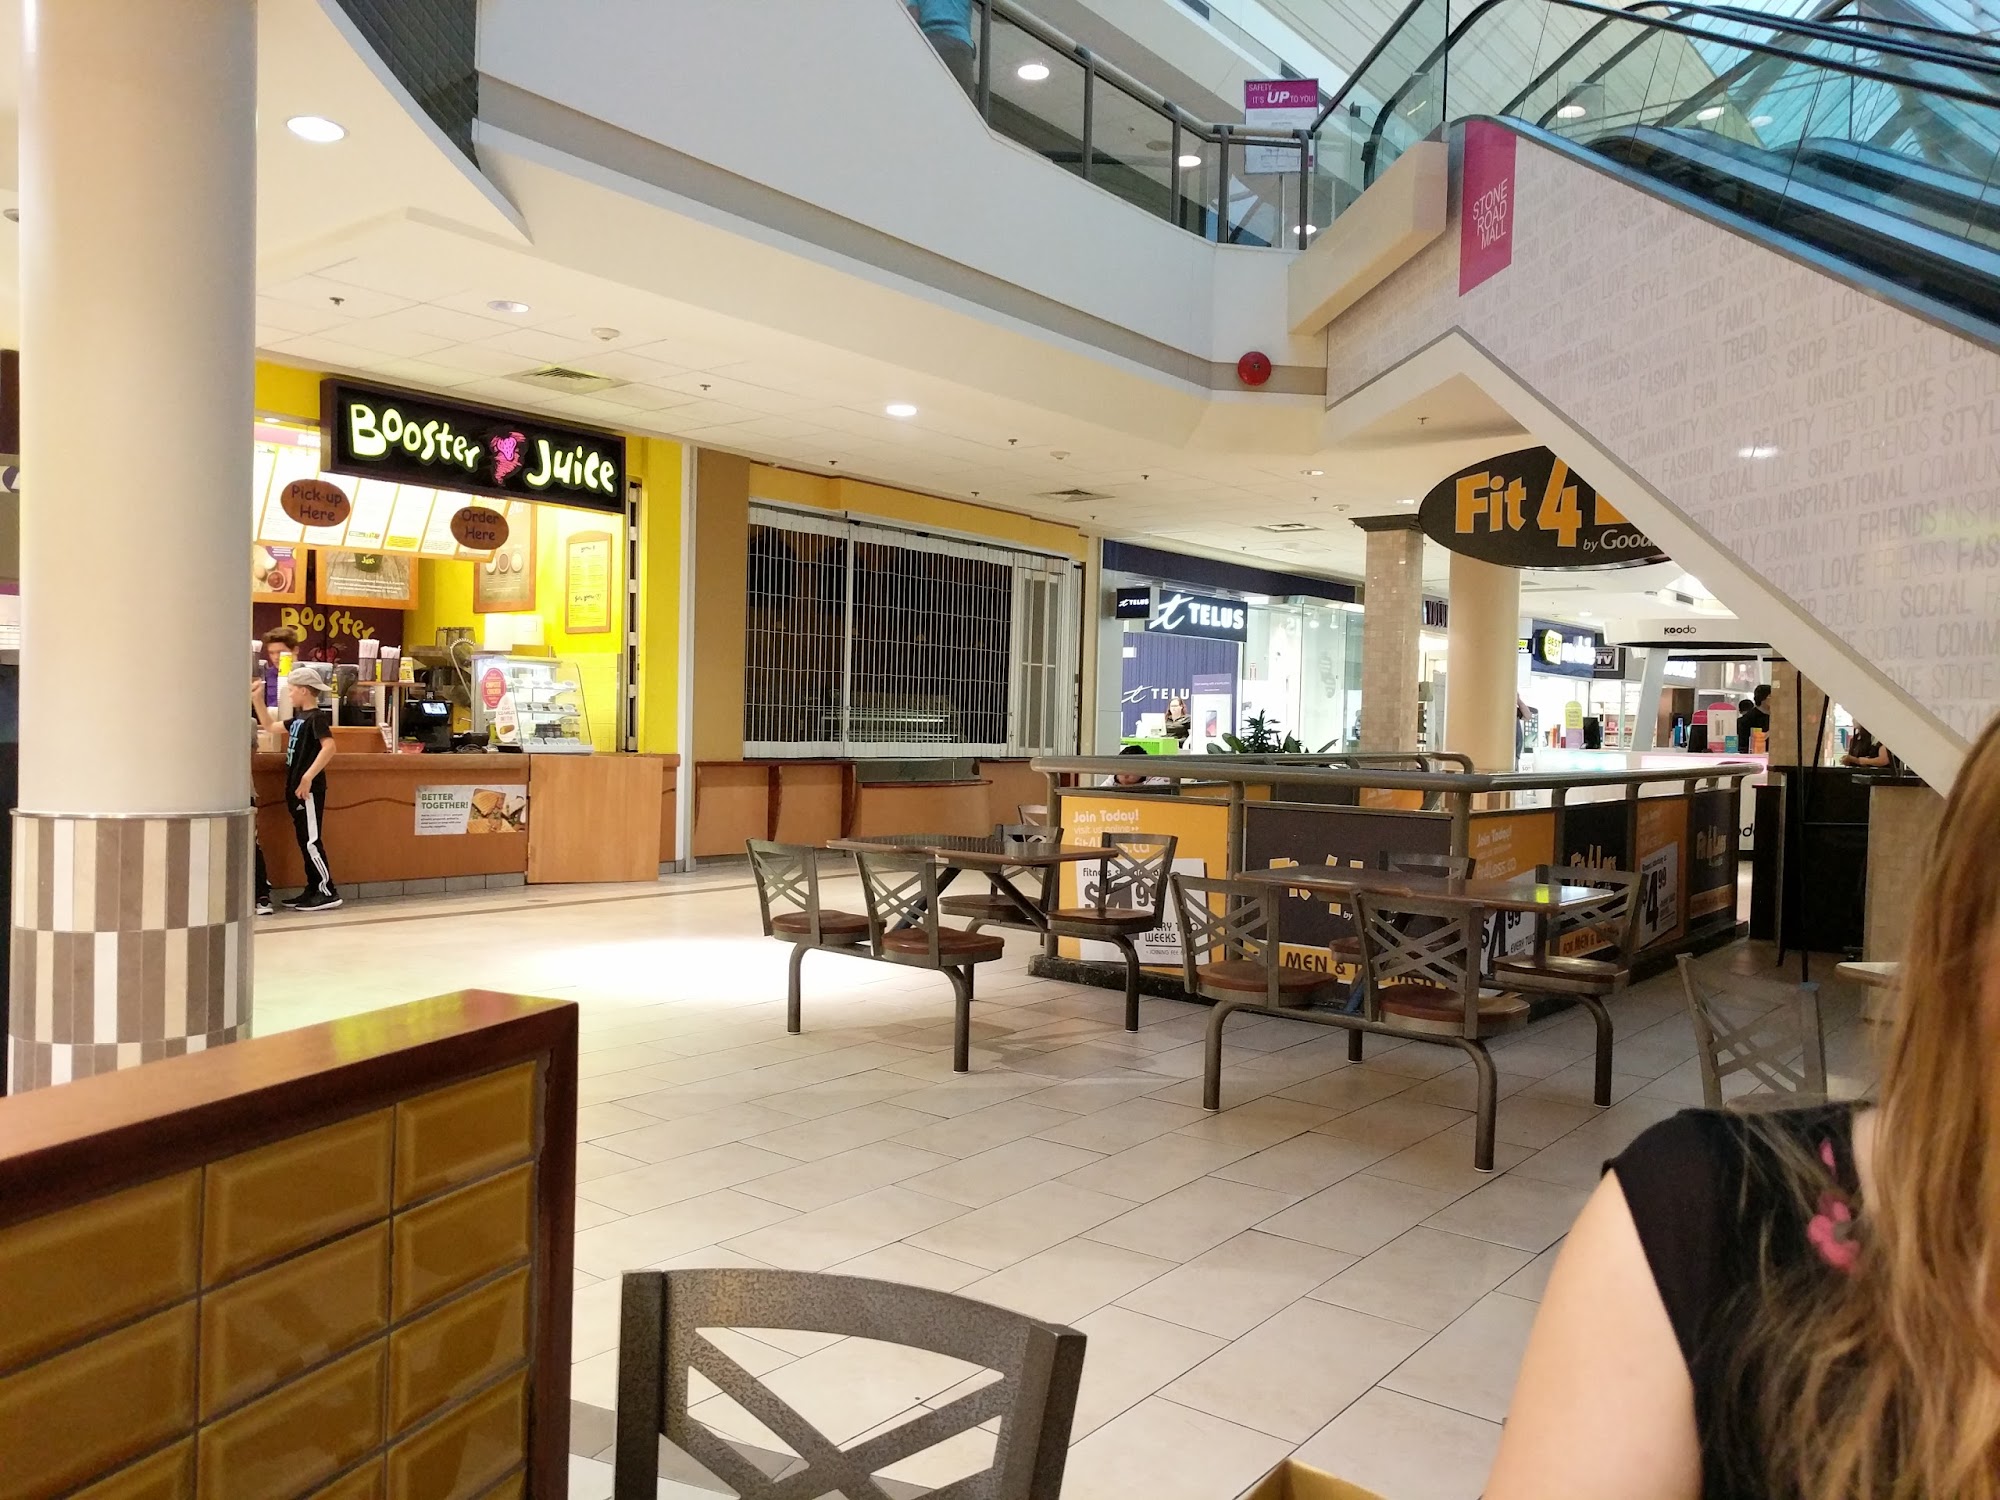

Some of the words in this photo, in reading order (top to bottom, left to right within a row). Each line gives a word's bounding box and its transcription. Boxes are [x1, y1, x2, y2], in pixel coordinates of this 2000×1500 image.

[1267, 91, 1290, 103] UP
[1299, 95, 1315, 103] YOU!
[1473, 178, 1508, 220] STONE
[1477, 200, 1507, 236] ROAD
[1481, 220, 1506, 250] MALL
[1631, 272, 1669, 312] STYLE
[1684, 276, 1725, 317] TREND
[1715, 287, 1769, 338] FAMILY
[1639, 357, 1687, 402] FASHION
[1723, 326, 1767, 367] TREND
[1609, 403, 1645, 441] SOCIAL
[1693, 378, 1717, 412] FUN
[1786, 337, 1827, 378] SHOP
[1627, 418, 1699, 463] COMMUNITY
[1807, 359, 1868, 407] UNIQUE
[1662, 445, 1713, 484] FASHION
[1884, 377, 1936, 422] LOVE
[526, 438, 615, 494] Juice
[1709, 466, 1757, 501] SOCIAL
[1808, 439, 1851, 478] SHOP
[291, 485, 342, 506] Pick-up
[1455, 471, 1527, 534] Fit
[1536, 457, 1582, 548] 4
[1778, 464, 1908, 522] INSPIRATIONAL
[300, 506, 335, 521] Here
[461, 509, 500, 524] Order
[1858, 500, 1938, 545] FRIENDS
[465, 527, 495, 541] Here
[1582, 538, 1599, 553] by
[1820, 553, 1866, 589] LOVE
[1129, 598, 1149, 606] TELUS
[1900, 579, 1971, 618] SOCIAL
[1188, 602, 1244, 630] TELUS
[1664, 625, 1697, 635] koodo
[1547, 635, 1562, 649] BEST
[1547, 647, 1560, 658] BUY
[1931, 662, 1993, 700] STYLE
[421, 793, 454, 801] BETTER
[421, 801, 469, 810] TOGETHER!
[1073, 811, 1097, 824] Join
[1100, 809, 1139, 825] Today!
[1074, 825, 1091, 834] visit
[1343, 911, 1353, 920] by
[1145, 933, 1177, 943] WEEKS
[1286, 951, 1328, 973] MEN
[1334, 962, 1347, 976] &
